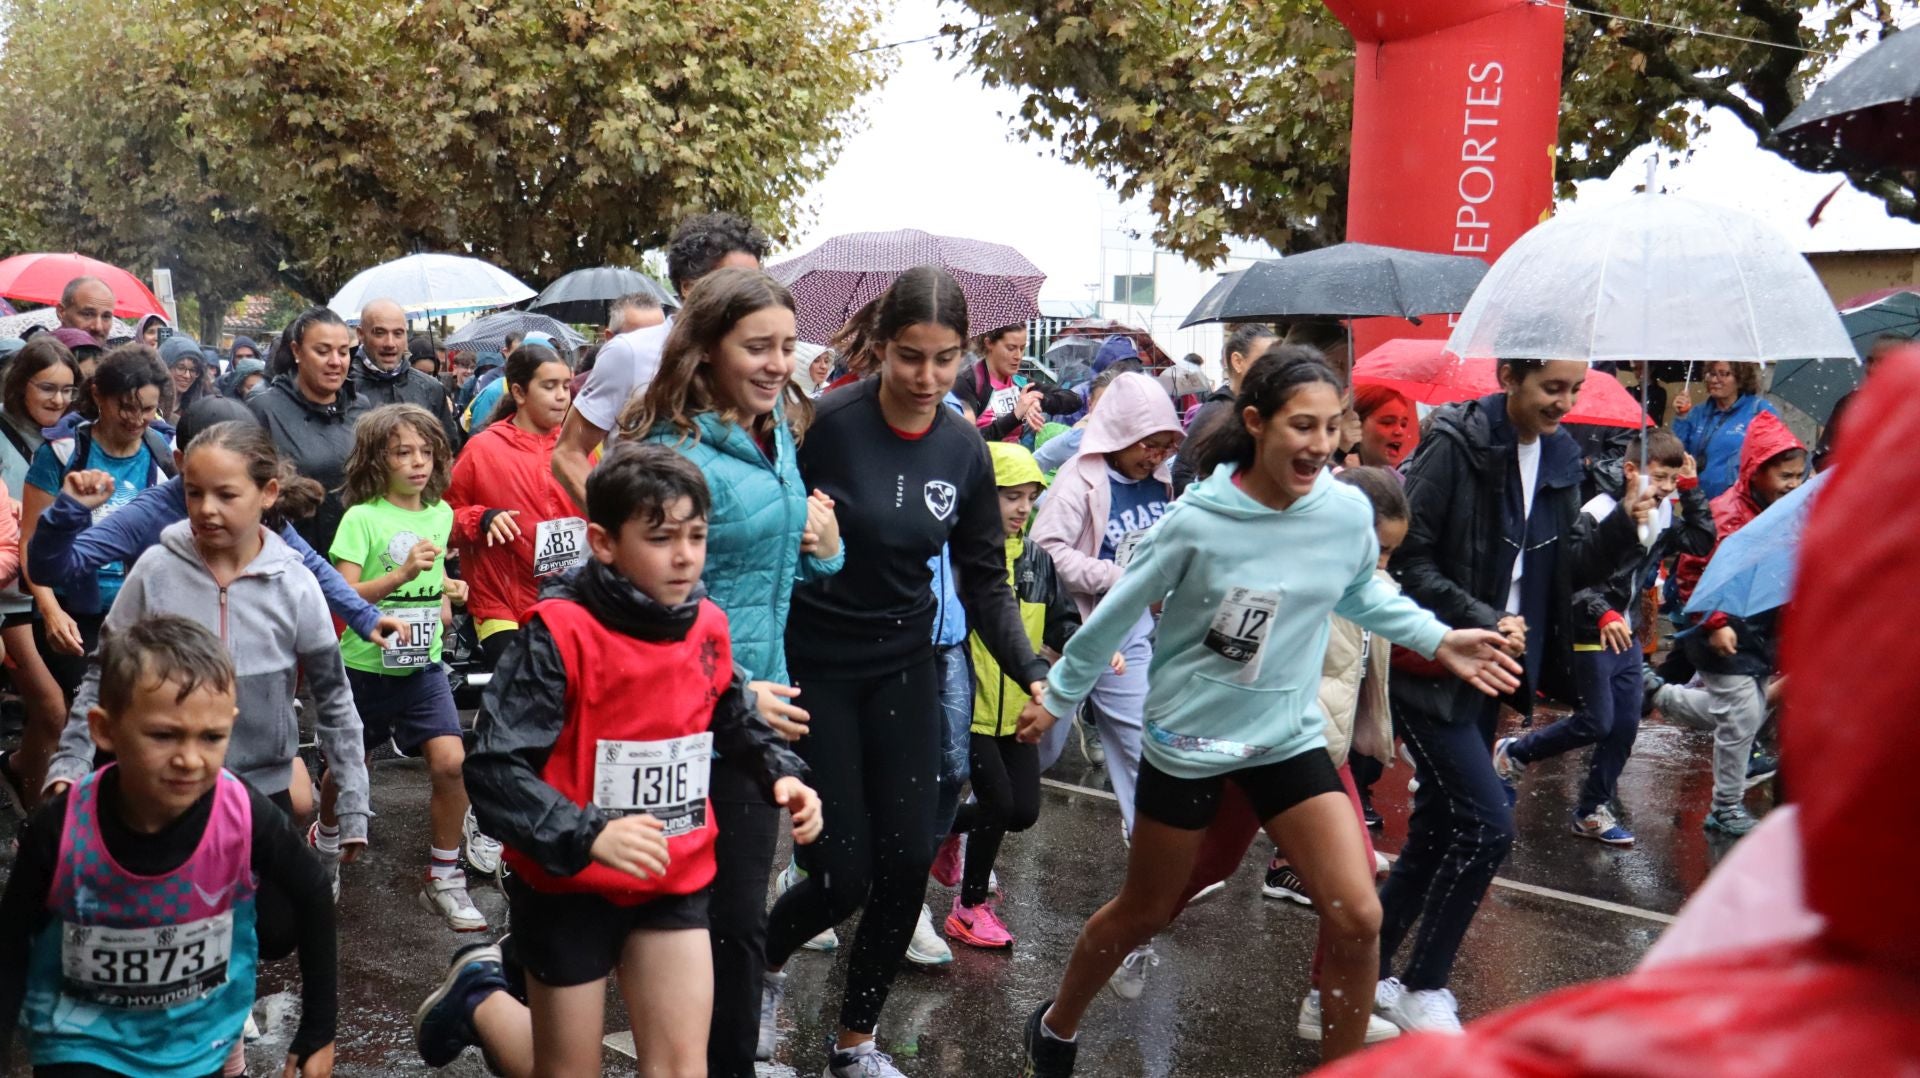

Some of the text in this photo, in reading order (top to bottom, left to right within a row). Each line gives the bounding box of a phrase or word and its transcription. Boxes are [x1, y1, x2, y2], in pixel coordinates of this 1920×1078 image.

[1453, 61, 1503, 252] EPORTES
[896, 475, 904, 508] KIPSTA
[539, 530, 575, 557] 383
[550, 558, 579, 569] HYUNDA
[1236, 608, 1269, 640] 12
[632, 763, 687, 805] 1316
[92, 940, 205, 983] 3873
